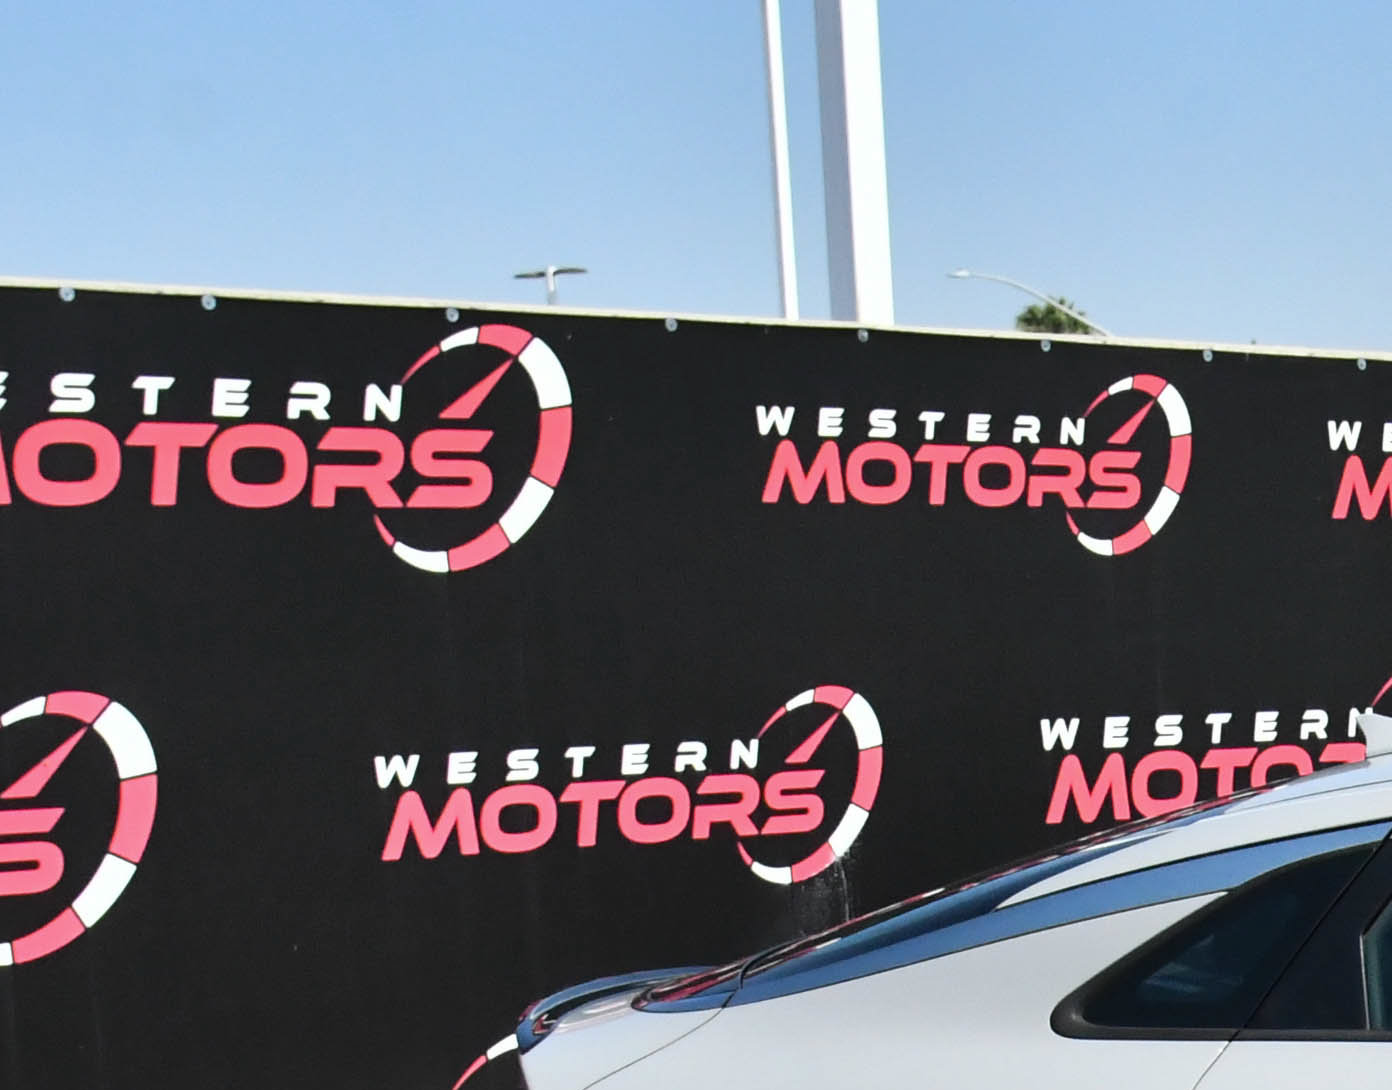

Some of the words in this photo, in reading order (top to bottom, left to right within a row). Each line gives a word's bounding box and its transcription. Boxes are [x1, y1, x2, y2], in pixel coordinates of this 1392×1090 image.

[0, 371, 403, 422] STERN
[755, 405, 1087, 446] WESTERN
[0, 417, 494, 509] OTORS
[761, 439, 1142, 510] MOTORS
[374, 738, 759, 789] WESTERN
[381, 769, 825, 862] MOTORS
